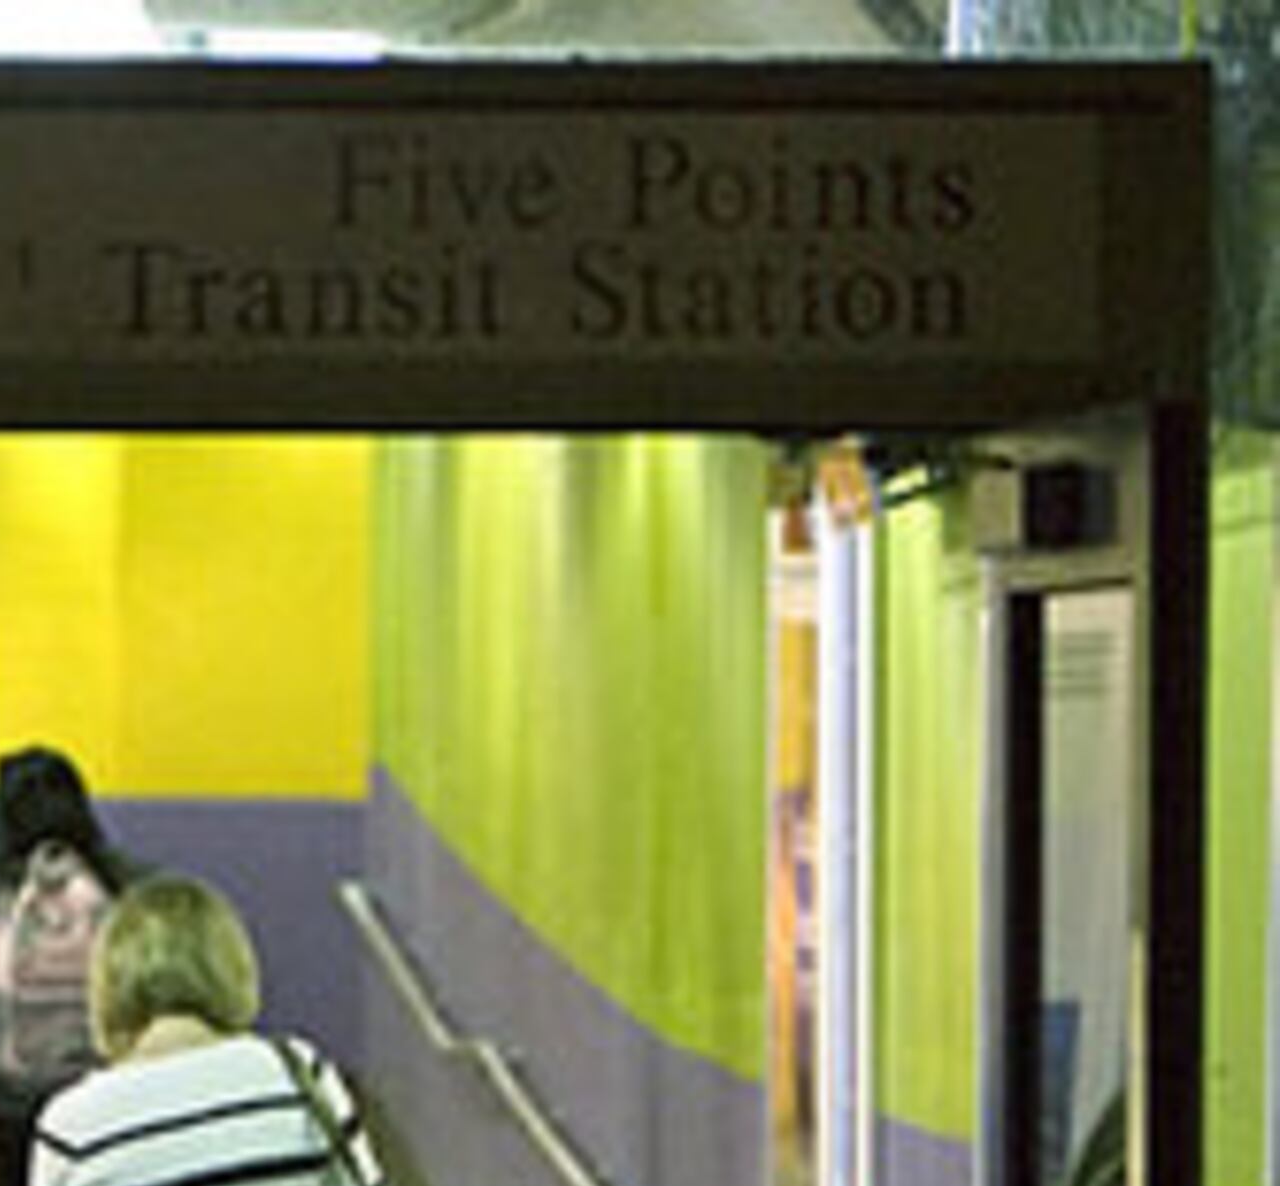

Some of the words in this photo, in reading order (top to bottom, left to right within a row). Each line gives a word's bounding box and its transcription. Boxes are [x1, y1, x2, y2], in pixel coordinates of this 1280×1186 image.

[334, 136, 558, 229] Five
[632, 138, 976, 231] Points
[104, 243, 504, 339] Transit
[572, 243, 968, 341] Station
